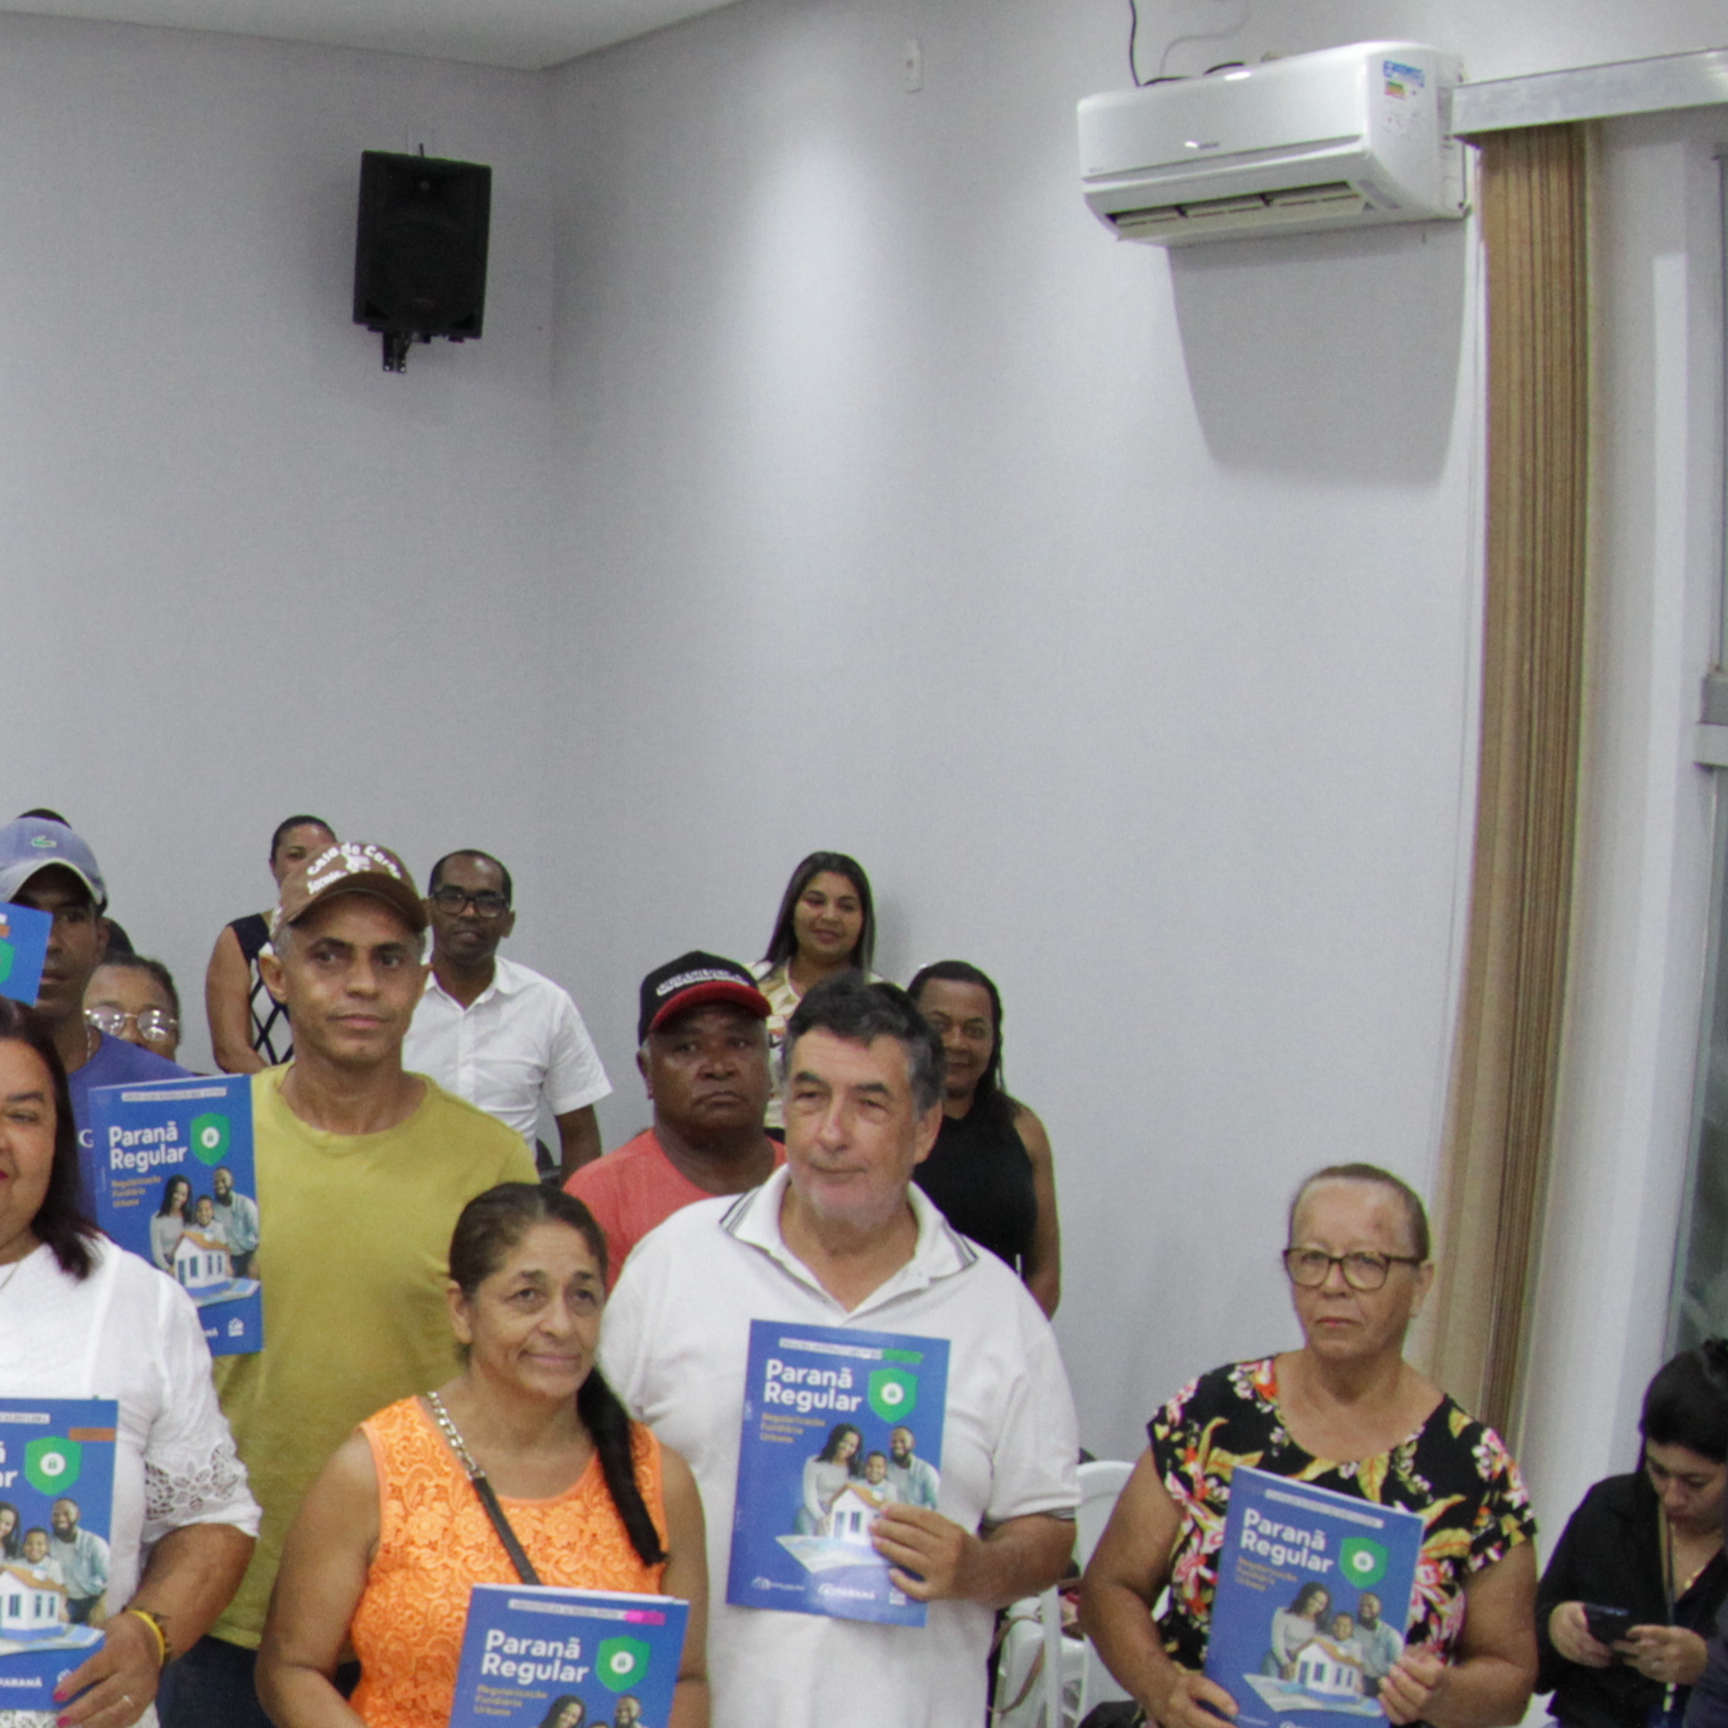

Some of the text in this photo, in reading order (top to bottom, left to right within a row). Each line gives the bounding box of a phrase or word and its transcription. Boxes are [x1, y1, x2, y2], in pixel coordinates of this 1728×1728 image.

[108, 1120, 178, 1148] Paranã
[110, 1143, 188, 1173] Regular
[765, 1358, 853, 1389] Paranã
[764, 1381, 862, 1413] Regular
[1243, 1507, 1326, 1551] Paranã
[1240, 1528, 1334, 1573] Regular
[486, 1627, 581, 1660] Paranã
[481, 1652, 590, 1686] Regular
